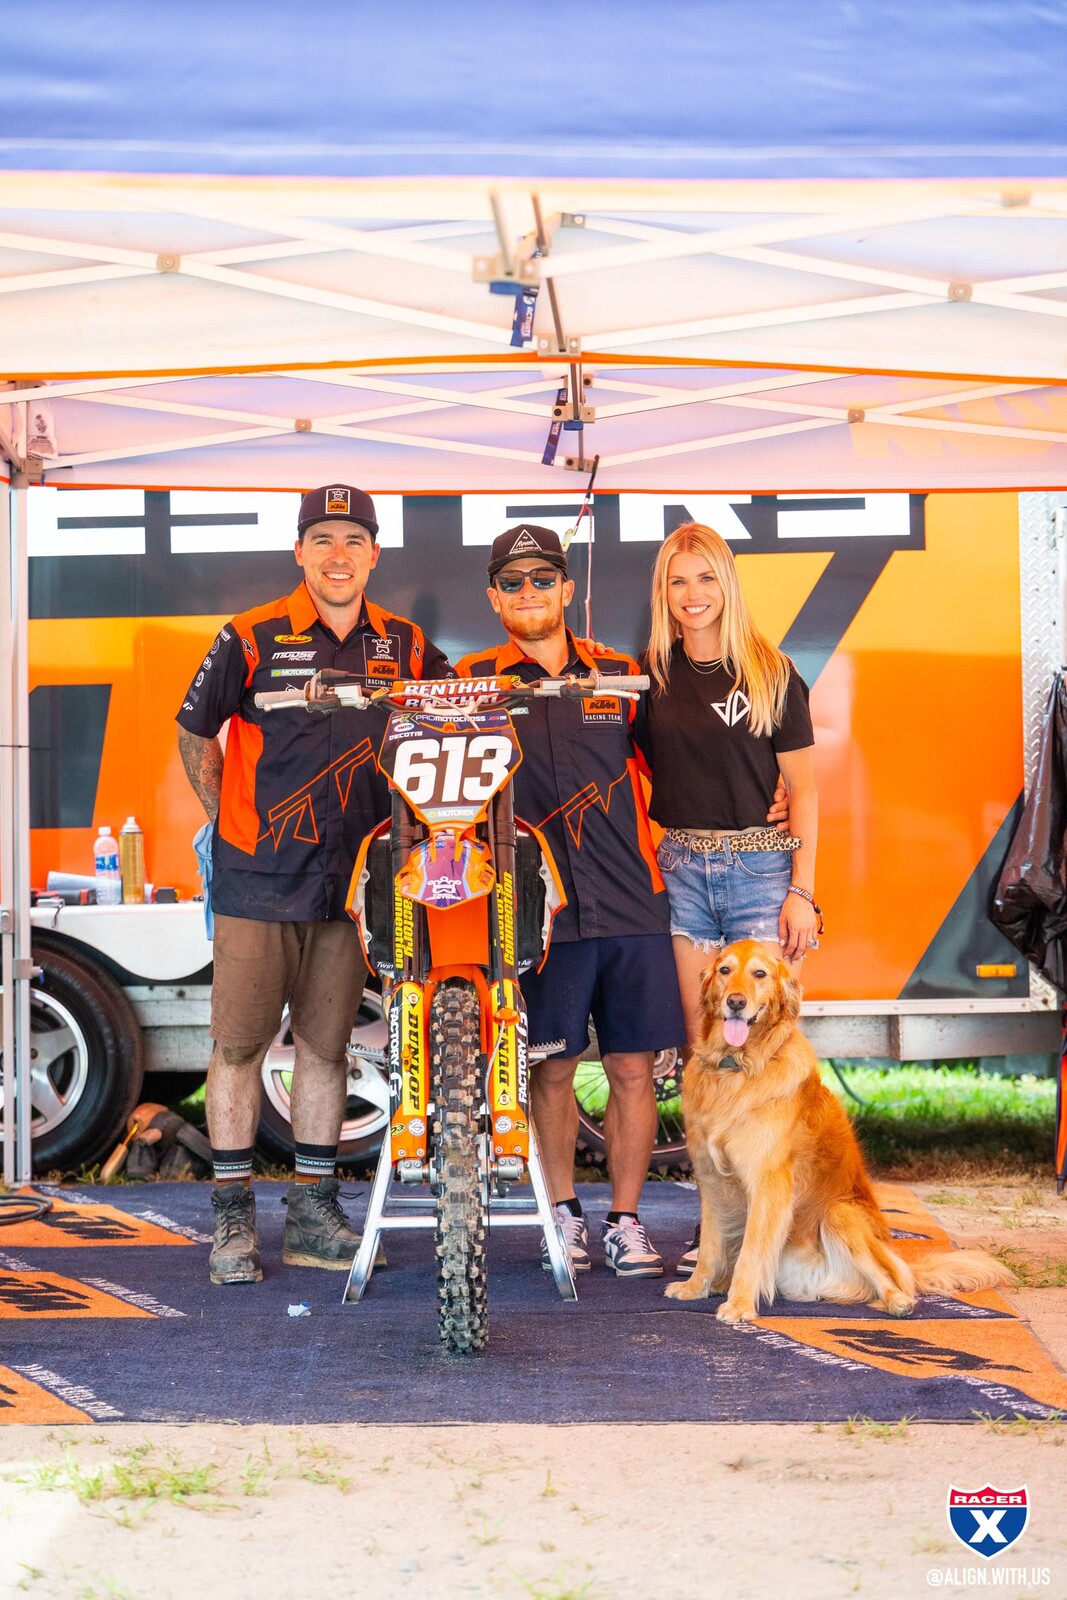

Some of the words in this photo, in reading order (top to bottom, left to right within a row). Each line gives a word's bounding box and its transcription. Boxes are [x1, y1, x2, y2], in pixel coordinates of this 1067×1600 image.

[271, 651, 317, 660] MOOSE
[281, 668, 315, 678] MOTOREX
[372, 665, 396, 675] KTM
[367, 678, 386, 686] RACING
[403, 680, 501, 696] RENTHAL
[589, 700, 616, 710] KTM
[389, 731, 423, 741] DECOTIS
[392, 735, 513, 805] 613
[437, 809, 475, 818] MOTOREX
[503, 871, 515, 967] connection
[403, 899, 414, 958] actory
[376, 961, 394, 969] Twin
[390, 1006, 400, 1066] FACTORY
[408, 1011, 420, 1110] DUNLOP
[517, 1037, 528, 1104] FACTORY
